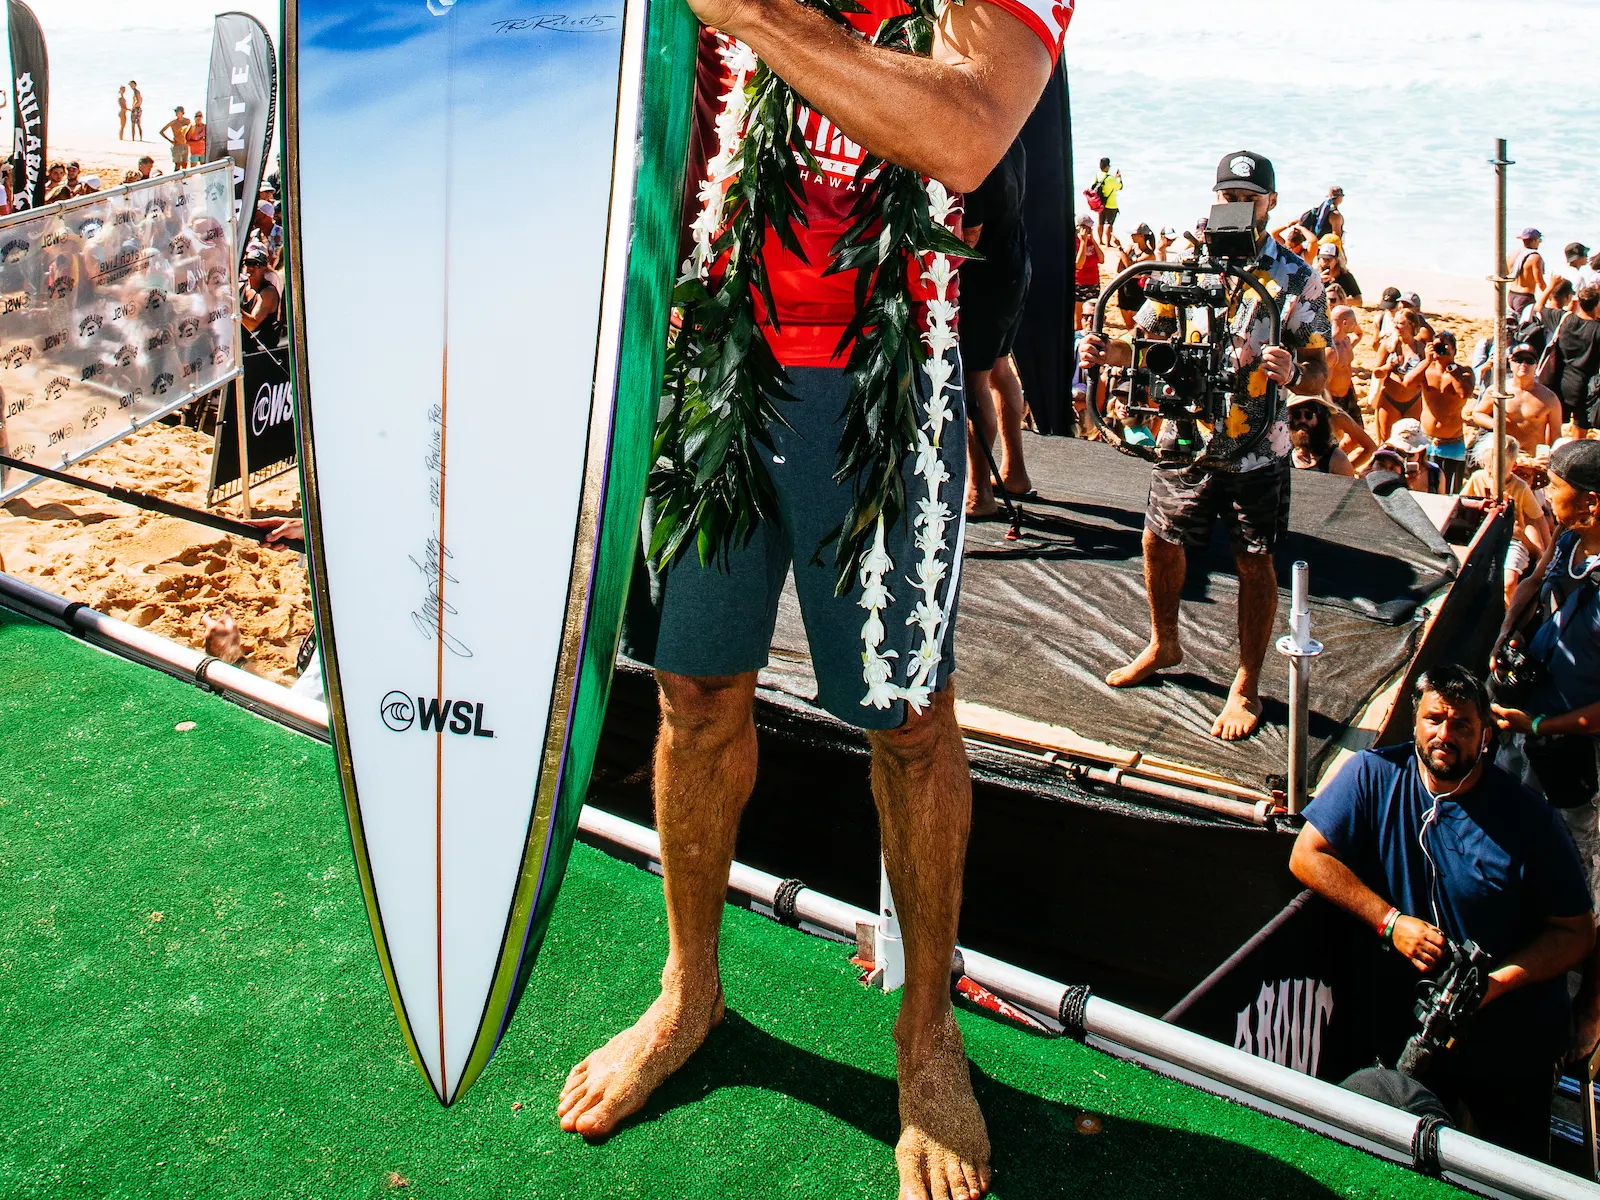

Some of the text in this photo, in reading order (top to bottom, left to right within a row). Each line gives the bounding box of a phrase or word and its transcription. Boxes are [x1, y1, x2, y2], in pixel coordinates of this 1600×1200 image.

[800, 171, 867, 193] HAWAI
[270, 381, 294, 427] WS
[417, 696, 494, 738] WSL
